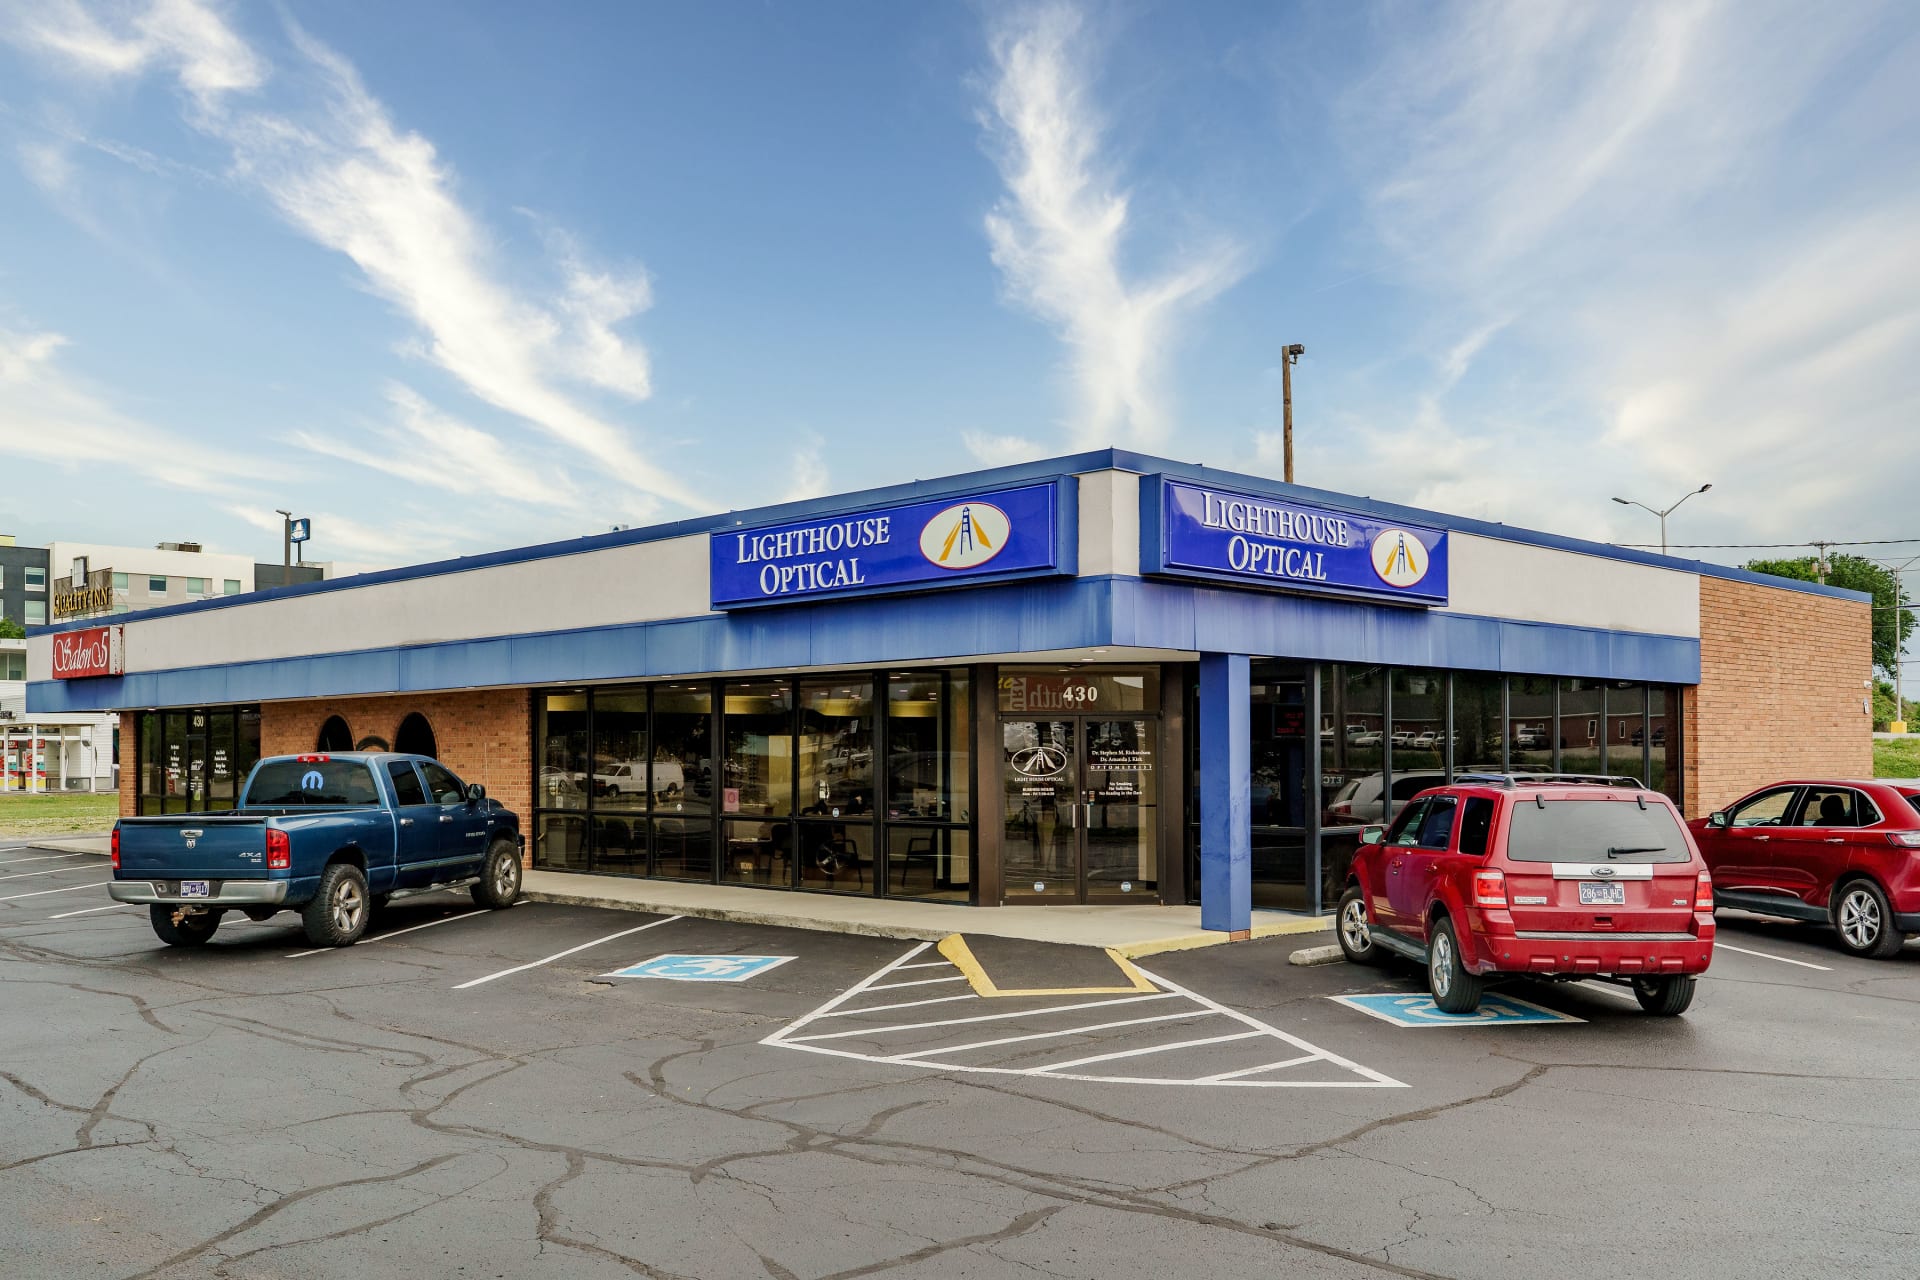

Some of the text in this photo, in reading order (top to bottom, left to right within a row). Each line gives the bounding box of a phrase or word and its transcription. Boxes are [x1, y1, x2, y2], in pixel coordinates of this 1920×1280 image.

[1201, 492, 1349, 547] LIGHTHOUSE
[736, 517, 891, 564] LIGHTHOUSE
[1228, 535, 1327, 581] OPTICAL
[759, 557, 866, 595] OPTICAL
[54, 586, 111, 616] QUALITY INN
[54, 632, 109, 672] Salon 5
[1062, 685, 1098, 702] 430
[193, 715, 204, 727] 430
